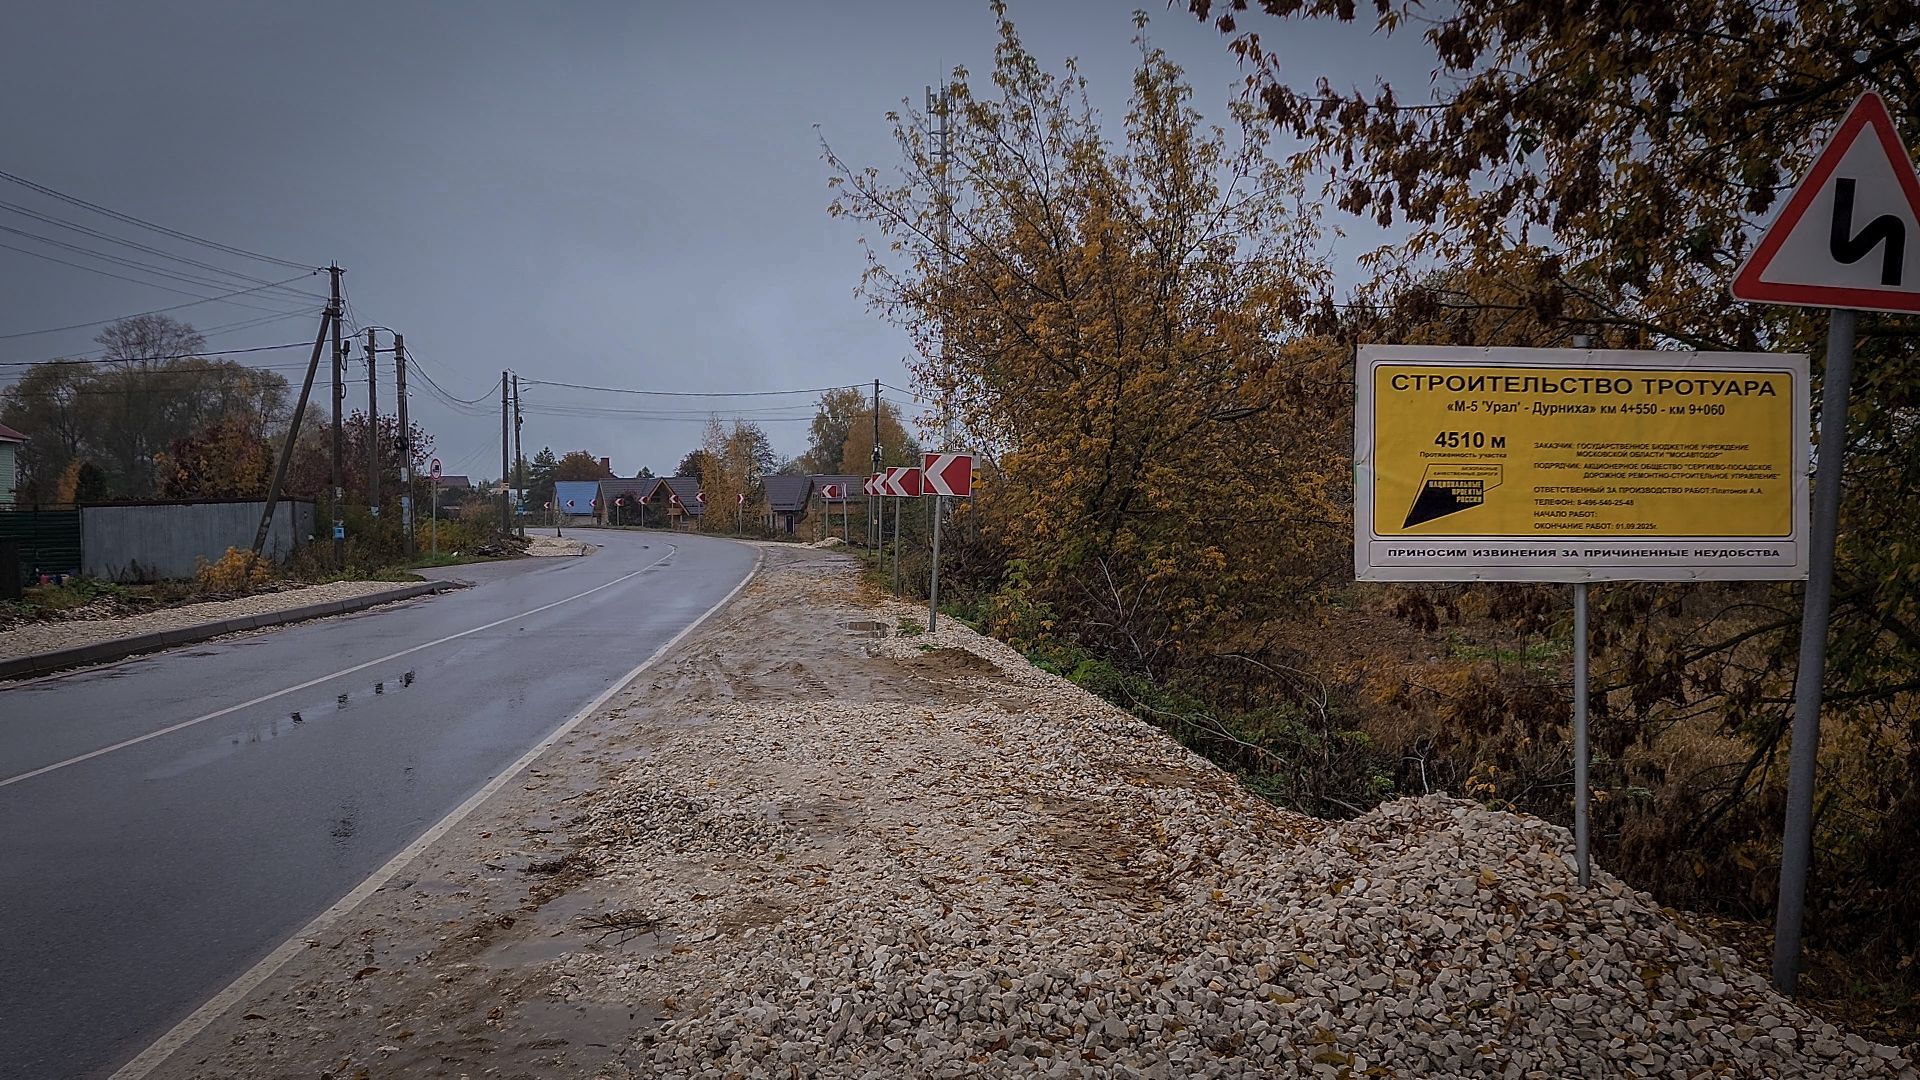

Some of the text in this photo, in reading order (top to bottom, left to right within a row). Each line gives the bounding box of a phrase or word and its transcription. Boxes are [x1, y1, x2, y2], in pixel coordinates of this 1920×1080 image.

[1391, 374, 1776, 396] СТРОИТЕЛЬСТВО ТРОТУАРА
[1447, 401, 1478, 412] «М-5
[1532, 402, 1596, 415] Дурниха»
[1620, 404, 1657, 415] 4+550
[1688, 405, 1725, 415] 9+060
[1435, 432, 1505, 448] 4510 м
[1388, 548, 1780, 558] ПРИНОСИМ ИЗВИНЕНИЯ ЗА ПРИЧИНЕННЫЕ НЕУДОБСТВА
